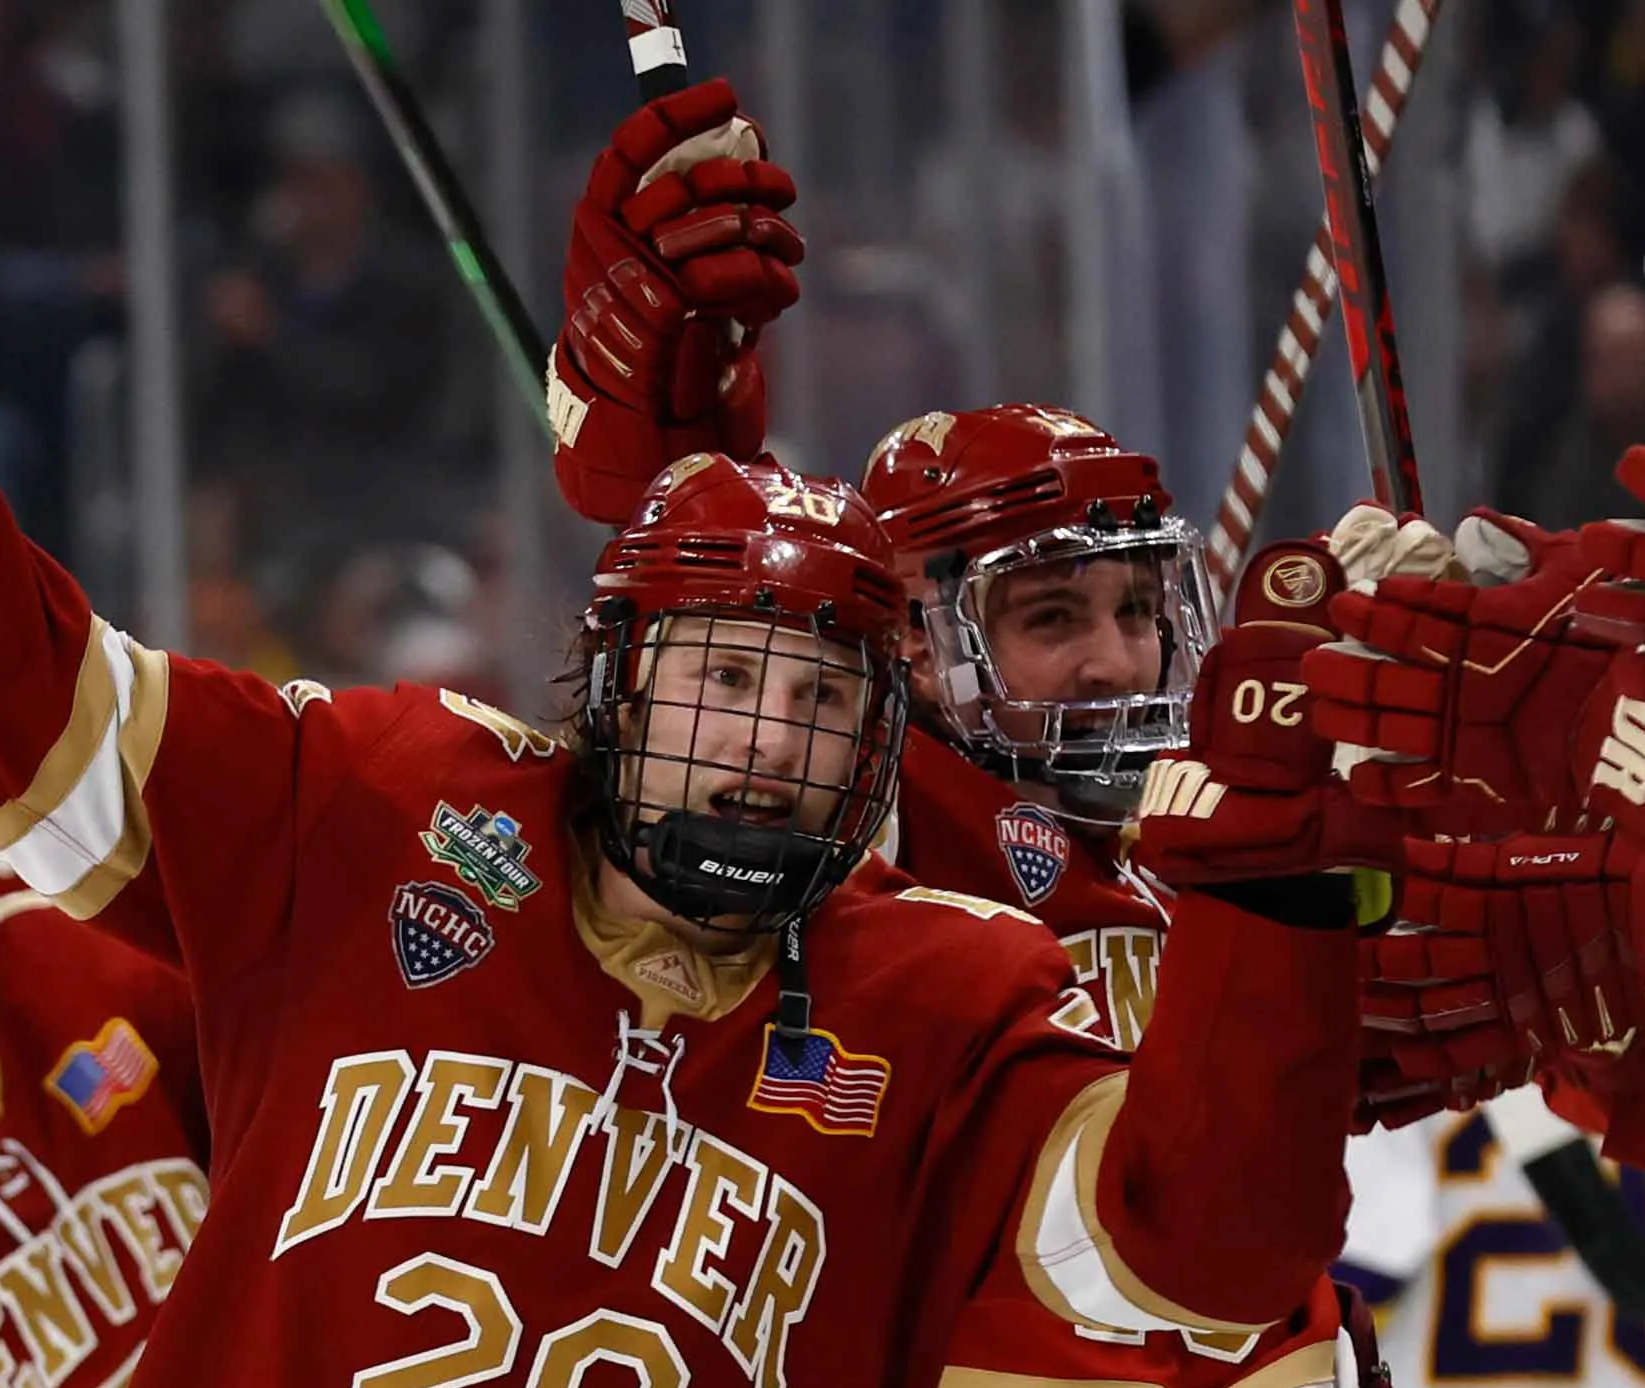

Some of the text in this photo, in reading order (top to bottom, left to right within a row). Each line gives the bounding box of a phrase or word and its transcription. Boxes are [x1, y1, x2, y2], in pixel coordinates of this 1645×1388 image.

[1231, 678, 1310, 727] 20
[441, 816, 497, 860] FROZEN
[491, 855, 531, 889] FOUR
[1000, 819, 1067, 862] NCHC
[396, 891, 488, 958] NCHC
[784, 917, 803, 963] UER
